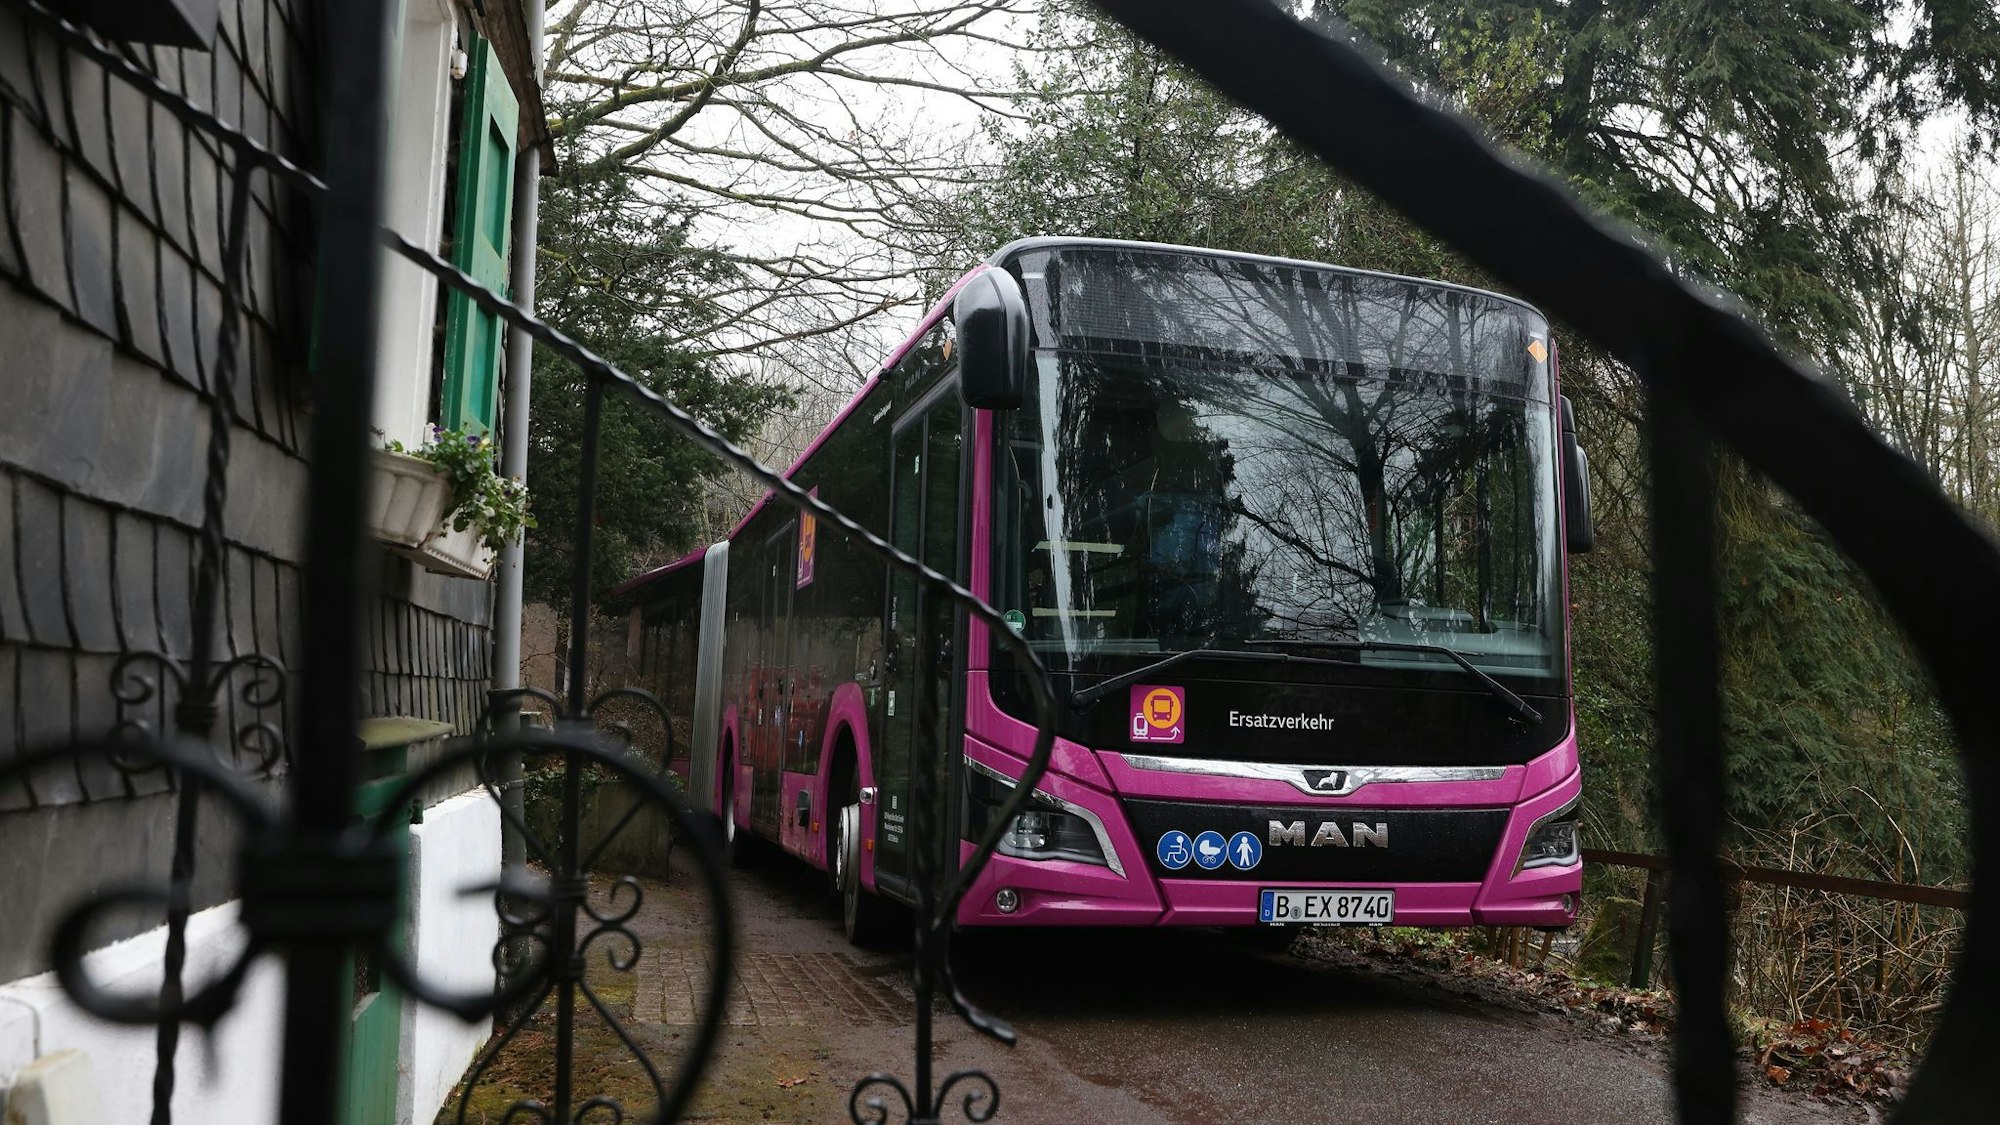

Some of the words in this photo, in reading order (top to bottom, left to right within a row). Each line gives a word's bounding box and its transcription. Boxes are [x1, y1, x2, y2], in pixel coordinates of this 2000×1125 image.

[1228, 711, 1334, 731] Ersatzverkehr
[1268, 820, 1389, 848] MAN
[1264, 909, 1271, 917] D
[1276, 896, 1290, 918] B
[1304, 896, 1333, 918] EX
[1337, 896, 1389, 919] 8740
